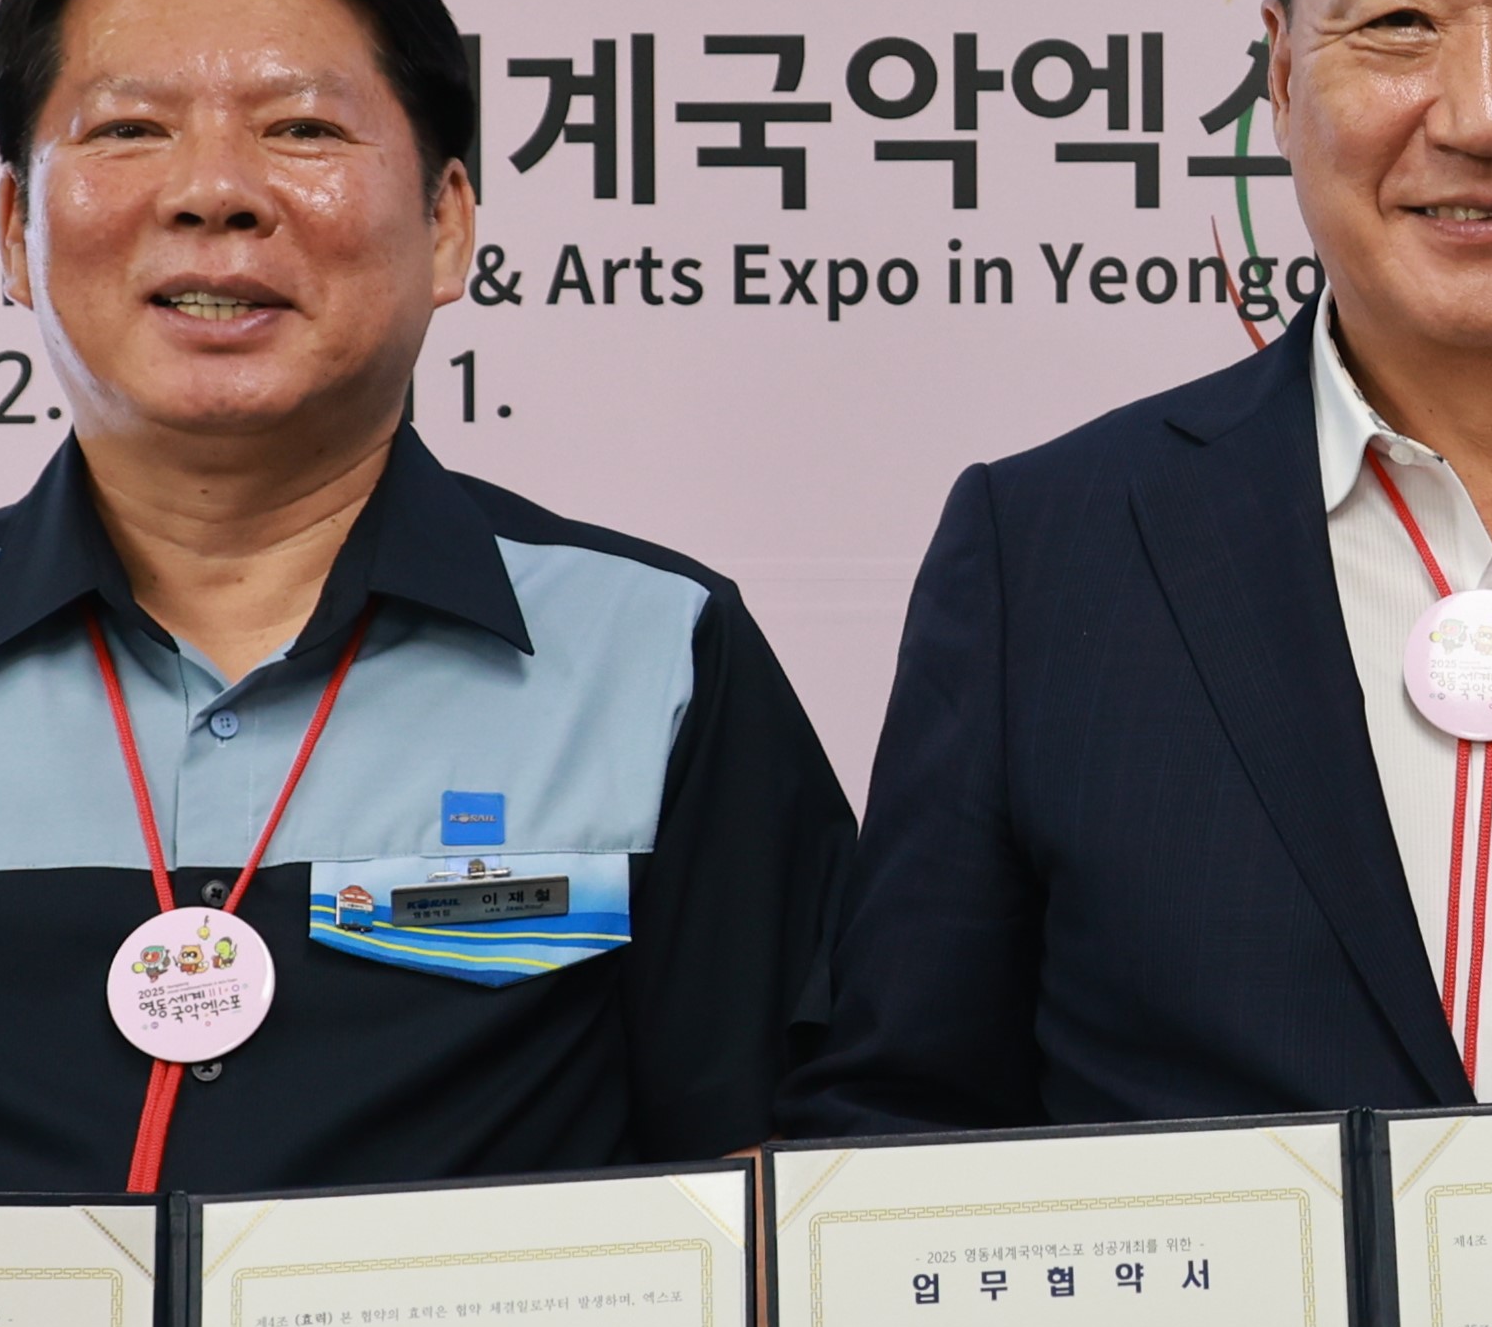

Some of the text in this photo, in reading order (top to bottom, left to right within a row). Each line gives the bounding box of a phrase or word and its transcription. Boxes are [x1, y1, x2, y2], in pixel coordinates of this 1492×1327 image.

[468, 244, 523, 306] &
[547, 245, 703, 305] Arts
[734, 245, 918, 321] Expo
[948, 239, 1012, 304] in
[449, 813, 497, 823] KORAIL
[407, 898, 460, 909] KORAIL
[139, 988, 165, 999] 2025
[928, 1251, 956, 1264] 2025
[1093, 1239, 1157, 1256] 성공개최를
[1167, 1237, 1191, 1252] 위한
